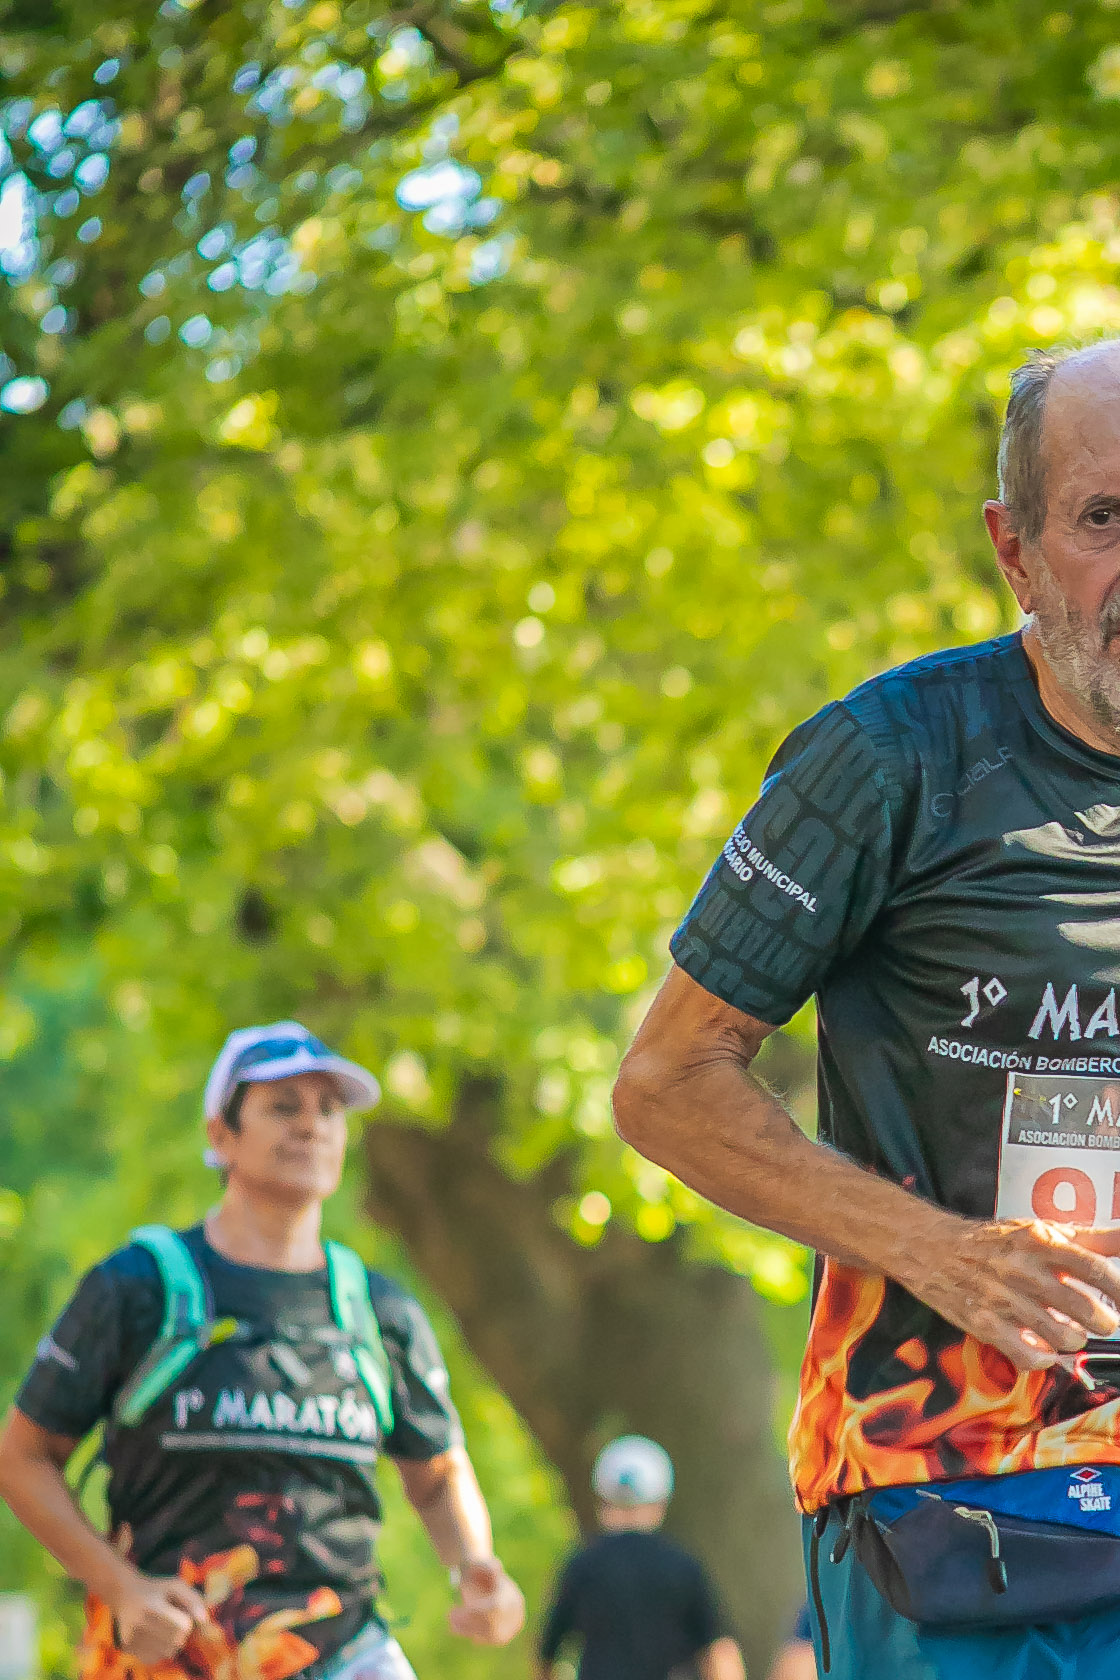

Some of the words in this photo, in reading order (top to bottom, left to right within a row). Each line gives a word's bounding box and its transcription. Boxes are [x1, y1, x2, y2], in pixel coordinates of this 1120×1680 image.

[746, 847, 818, 913] MUNICIPAL
[927, 1036, 1032, 1070] ASOCIACIÓN
[1079, 1496, 1111, 1512] SKATE
